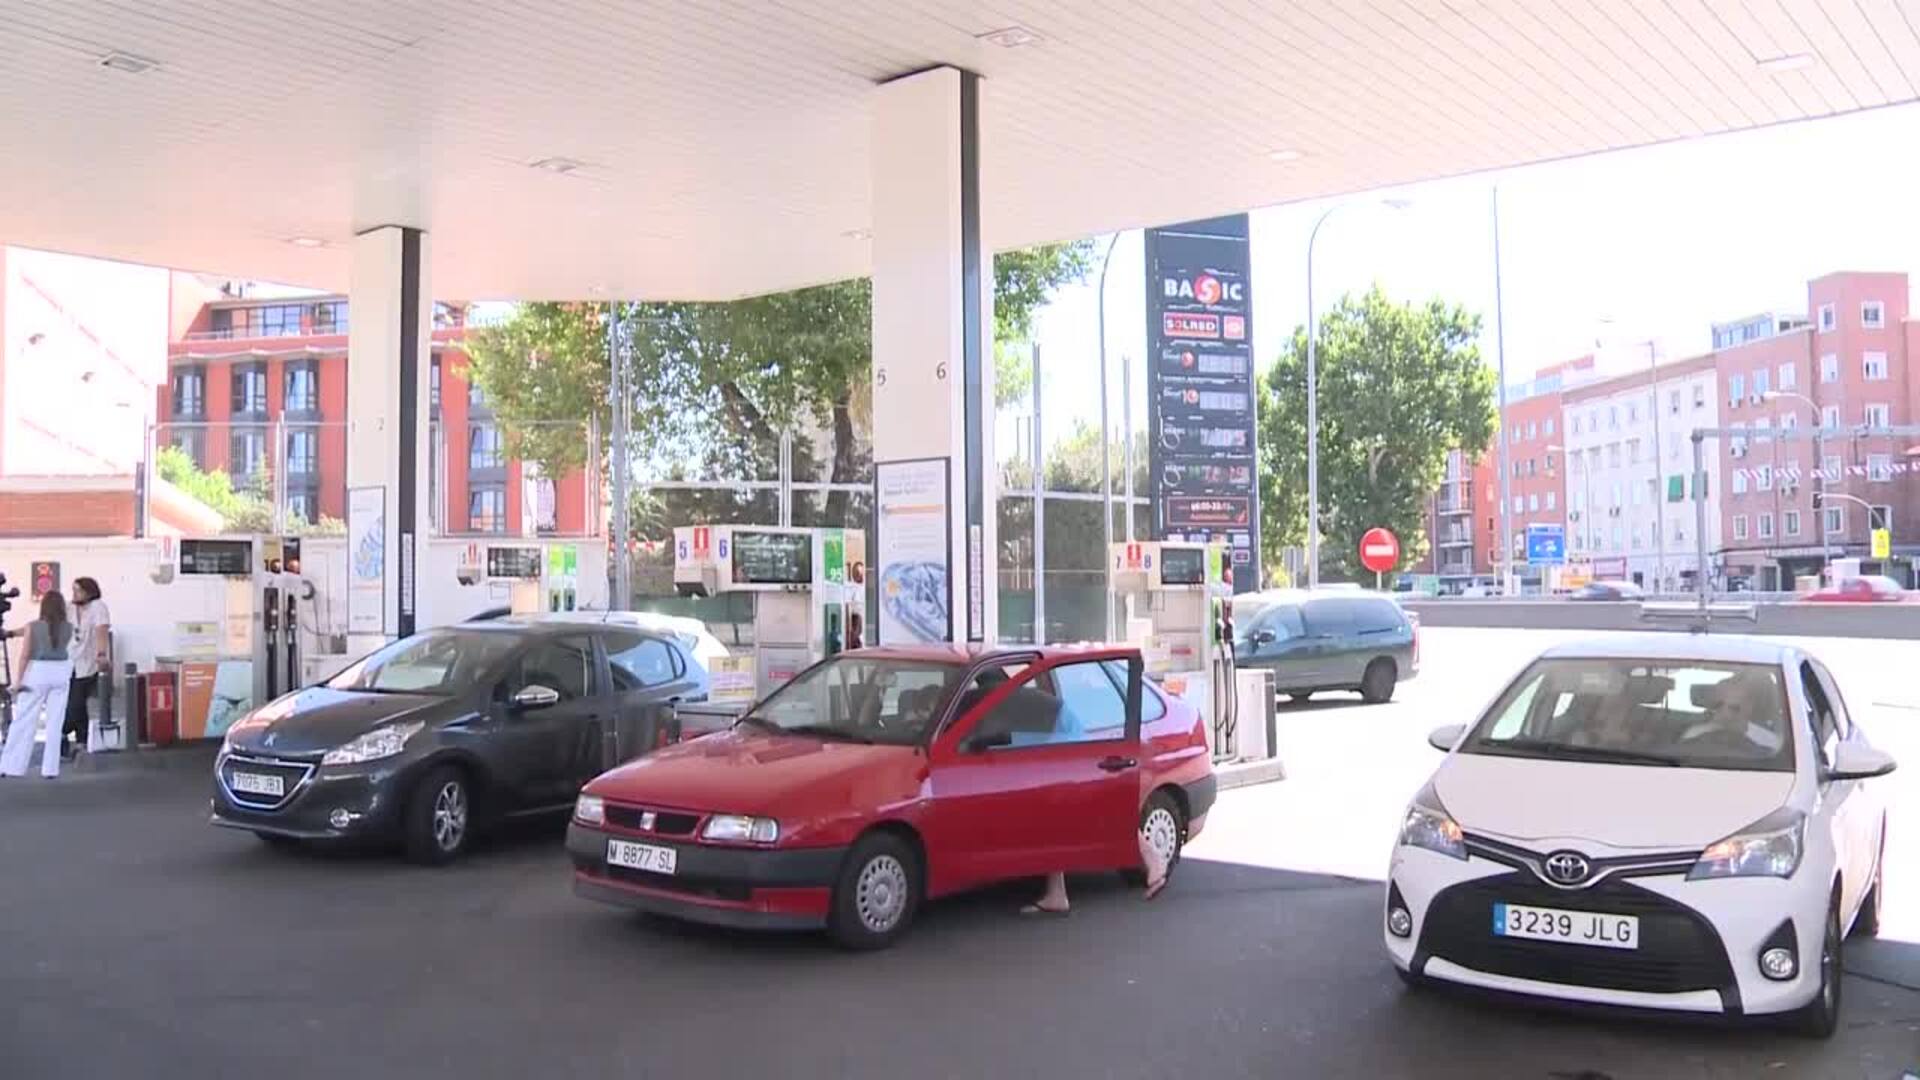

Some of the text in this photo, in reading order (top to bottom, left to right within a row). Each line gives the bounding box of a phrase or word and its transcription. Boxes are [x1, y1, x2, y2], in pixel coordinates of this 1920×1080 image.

[1164, 274, 1242, 303] BASIC
[877, 368, 886, 386] 5
[936, 361, 946, 380] 6
[679, 540, 687, 560] 5
[719, 539, 728, 559] 6
[830, 567, 843, 581] 95
[658, 850, 672, 871] SL
[1509, 909, 1631, 942] 3239 JLG
